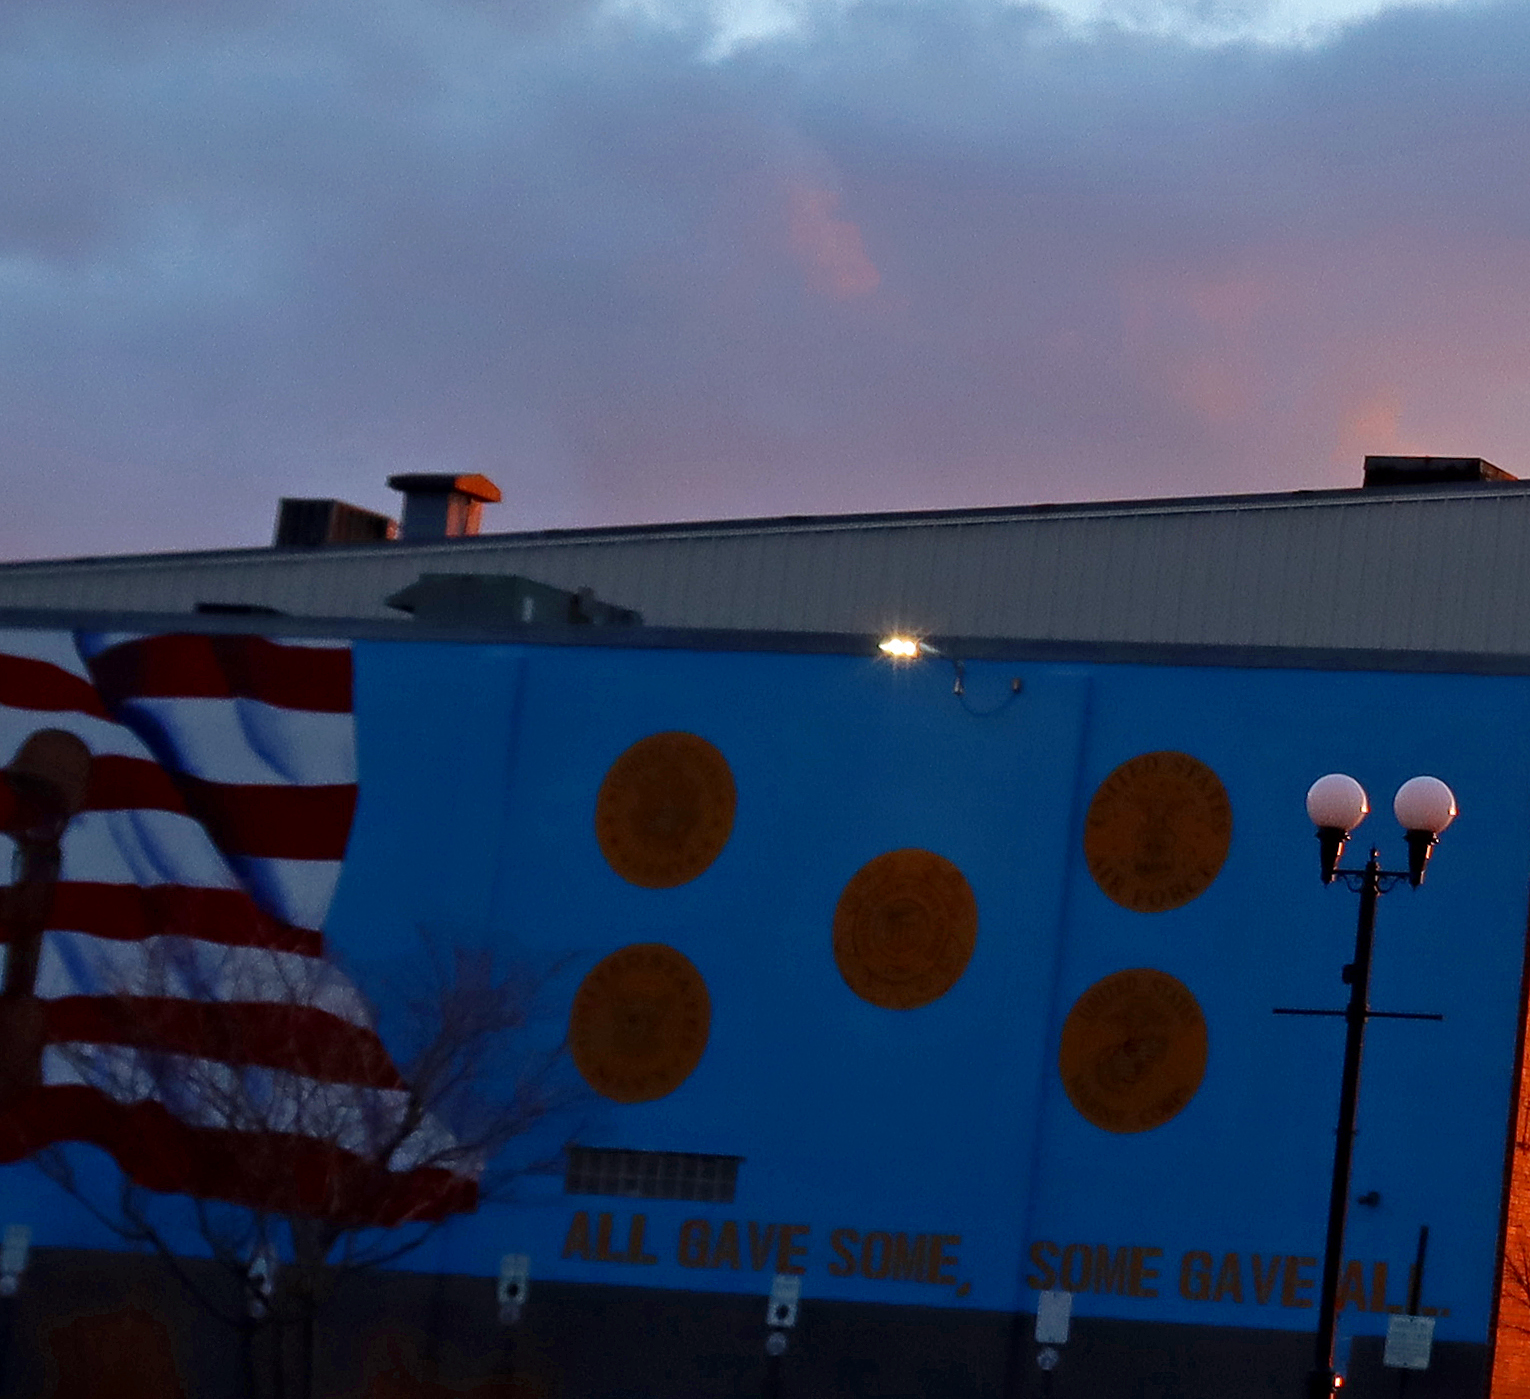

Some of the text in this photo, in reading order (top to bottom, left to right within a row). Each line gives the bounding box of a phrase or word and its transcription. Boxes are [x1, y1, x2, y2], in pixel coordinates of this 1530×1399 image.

[562, 1210, 657, 1265] ALL
[678, 1218, 810, 1276] GAVE
[828, 1227, 971, 1297] SOME,
[1027, 1240, 1163, 1299] SOME
[1179, 1249, 1319, 1309] GAVE
